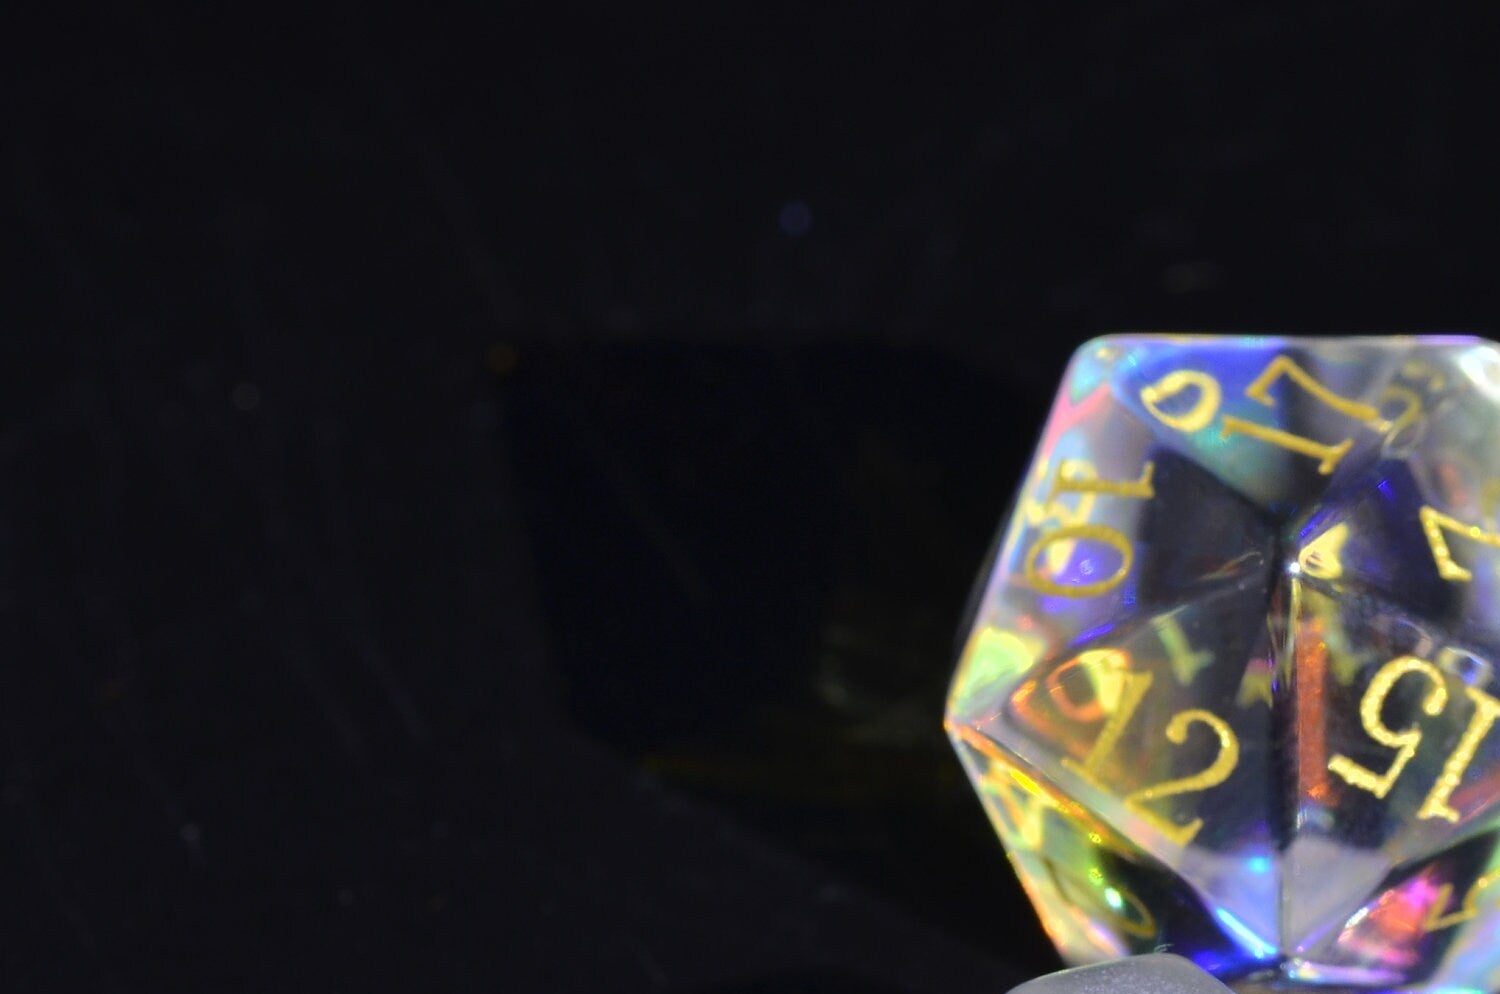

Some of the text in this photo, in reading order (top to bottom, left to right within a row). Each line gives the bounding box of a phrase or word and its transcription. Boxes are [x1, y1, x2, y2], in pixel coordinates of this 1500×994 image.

[1222, 355, 1388, 476] 17
[1024, 460, 1156, 598] 10
[1061, 671, 1241, 847] 12
